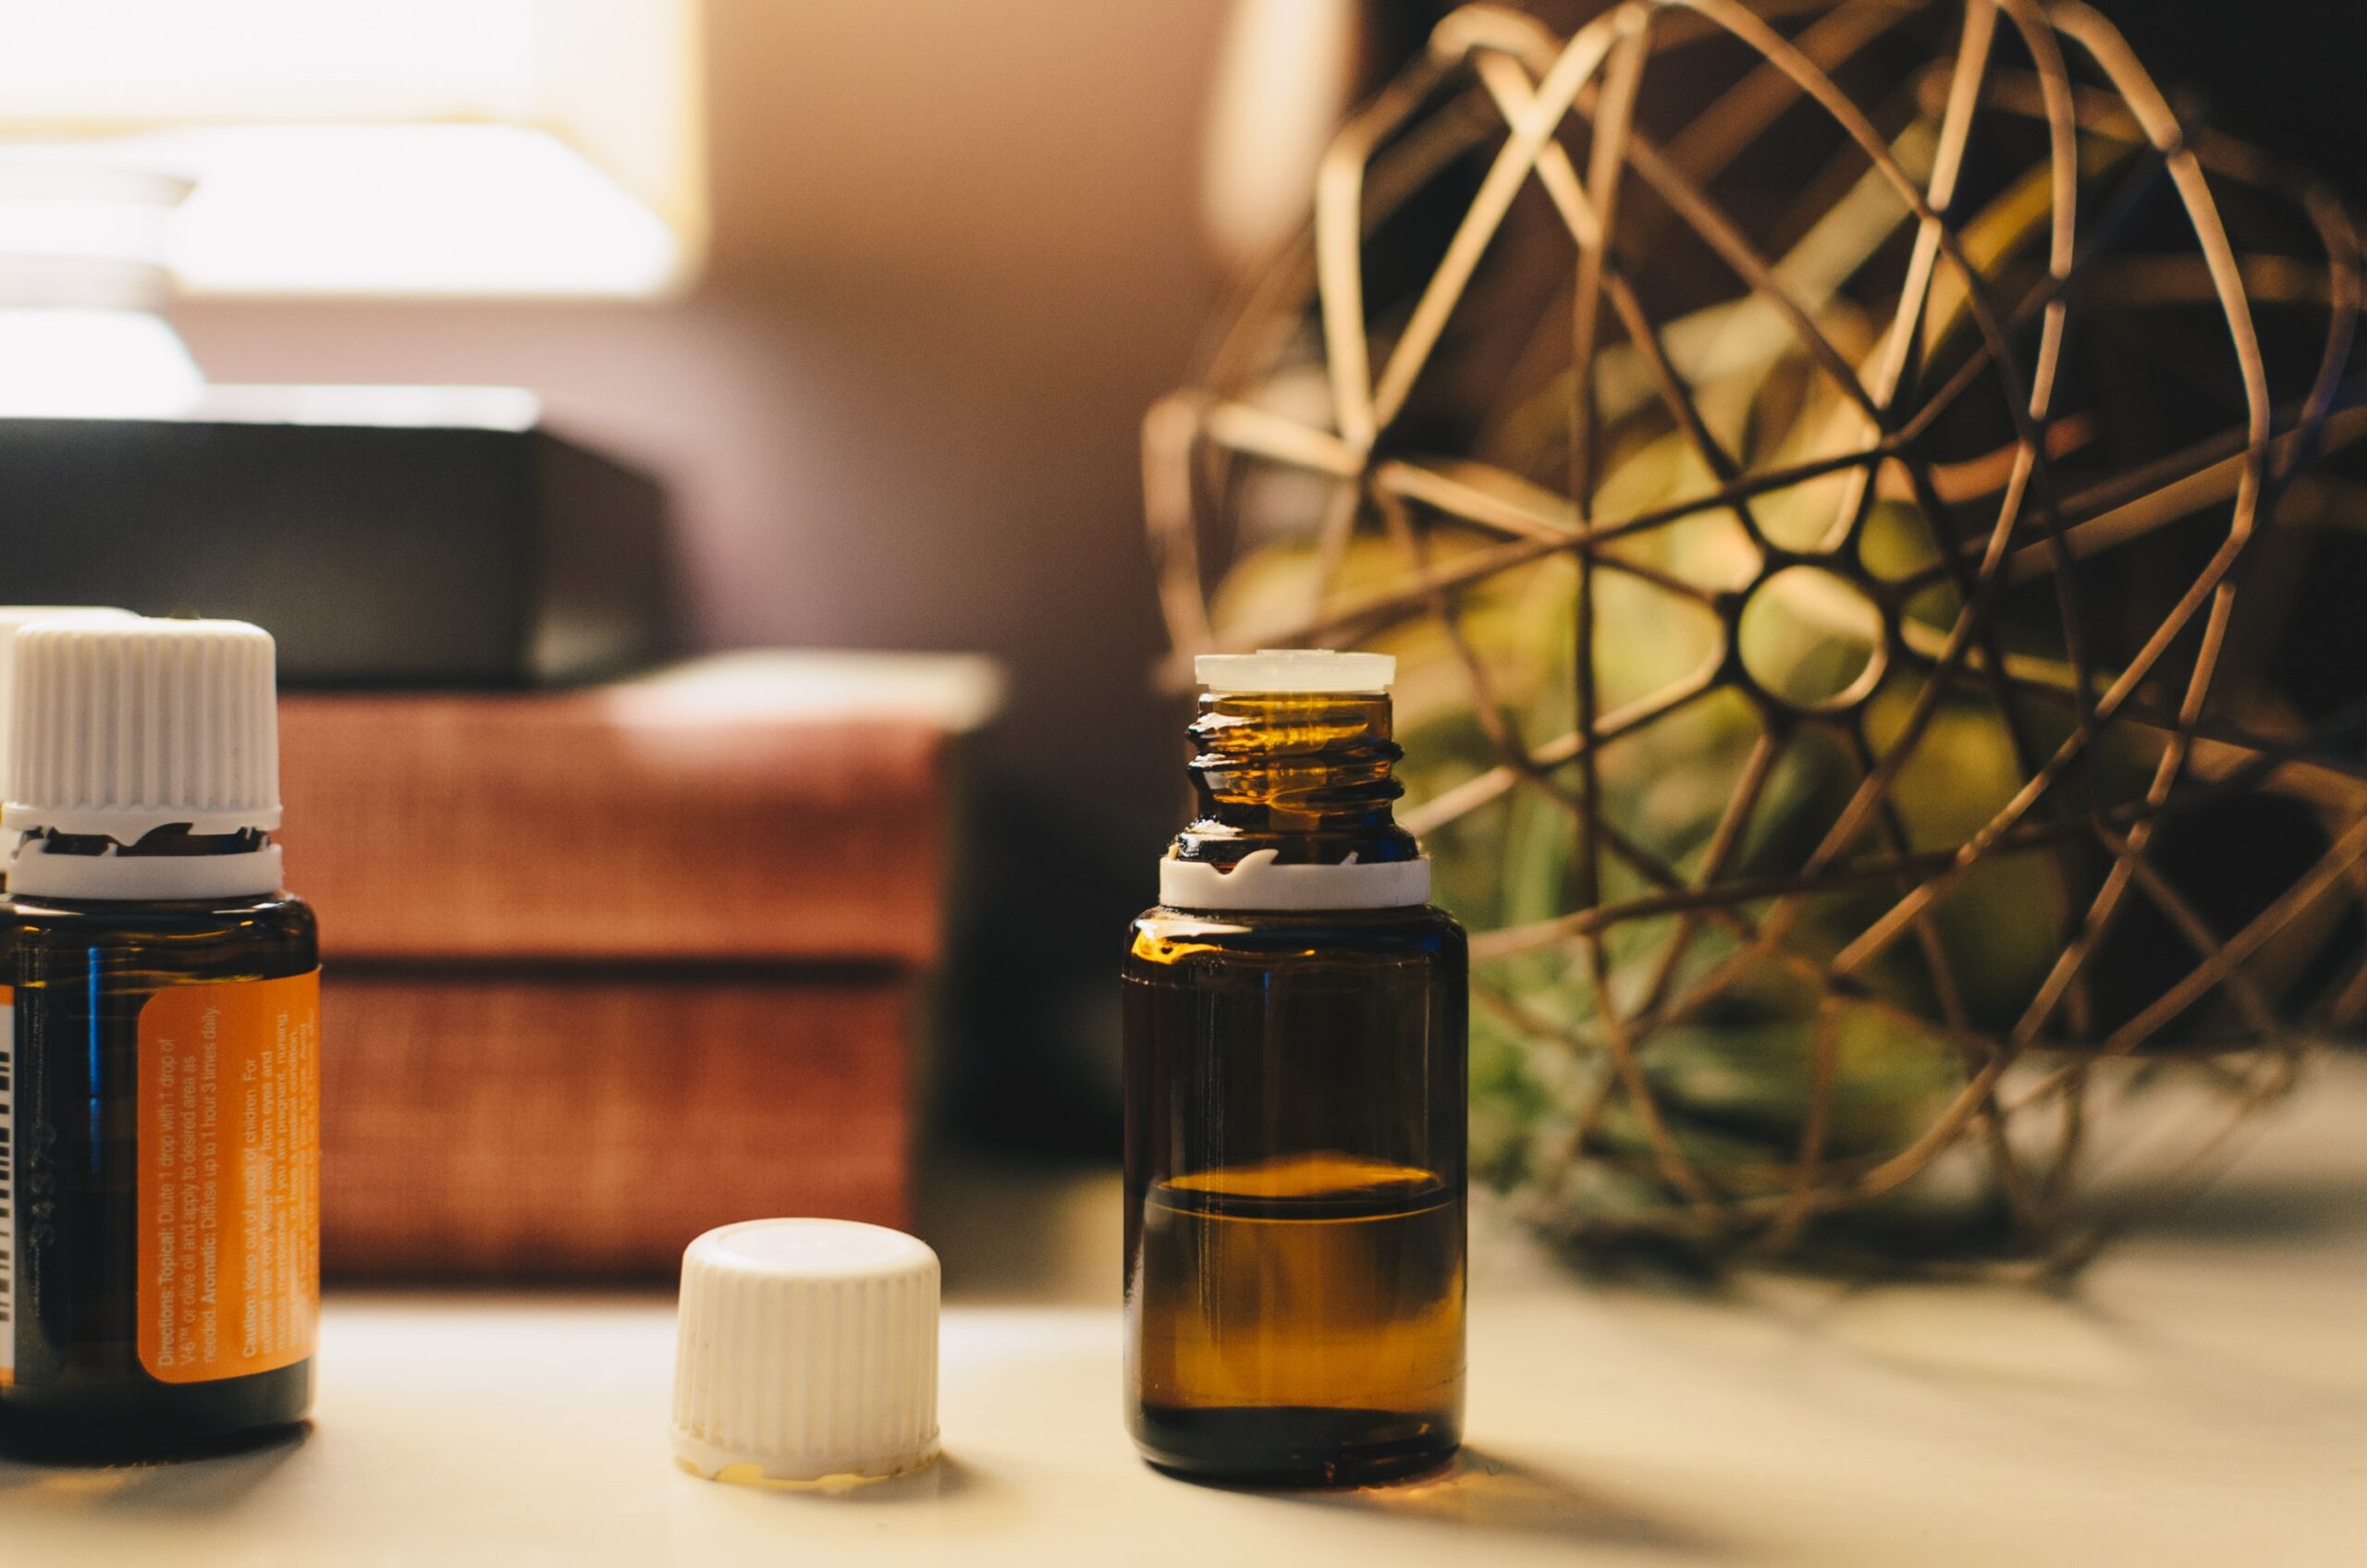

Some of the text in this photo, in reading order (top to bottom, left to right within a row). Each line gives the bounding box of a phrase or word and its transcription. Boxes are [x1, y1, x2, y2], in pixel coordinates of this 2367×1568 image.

[158, 1037, 177, 1052] of
[159, 1055, 179, 1087] drop
[183, 1054, 197, 1072] as
[202, 1041, 217, 1081] times
[242, 1058, 258, 1082] For
[260, 1049, 275, 1076] and
[183, 1073, 197, 1109] area
[201, 1082, 217, 1093] 3
[262, 1081, 276, 1114] eyes
[158, 1103, 176, 1132] with
[201, 1095, 217, 1127] hour
[179, 1110, 197, 1162] desired
[201, 1131, 217, 1139] 1
[202, 1142, 217, 1156] to
[260, 1117, 275, 1150] from
[159, 1134, 178, 1167] drop
[242, 1146, 259, 1160] of
[180, 1165, 197, 1180] to
[203, 1157, 221, 1177] up
[276, 1163, 288, 1191] you
[243, 1163, 258, 1205] reach
[157, 1182, 176, 1223] Dilute
[180, 1182, 201, 1220] apply
[200, 1180, 217, 1229] Diffuse
[242, 1209, 258, 1223] of
[261, 1195, 276, 1233] Keep
[180, 1225, 197, 1251] and
[243, 1227, 258, 1249] out
[157, 1227, 179, 1285] Topical:
[180, 1254, 197, 1269] oil
[200, 1231, 217, 1304] Aromatic:
[242, 1252, 260, 1291] Keep
[180, 1272, 197, 1305] olive
[157, 1285, 176, 1366] Directions:
[183, 1307, 197, 1323] or
[242, 1294, 258, 1357] Caution:
[200, 1305, 217, 1362] needed.
